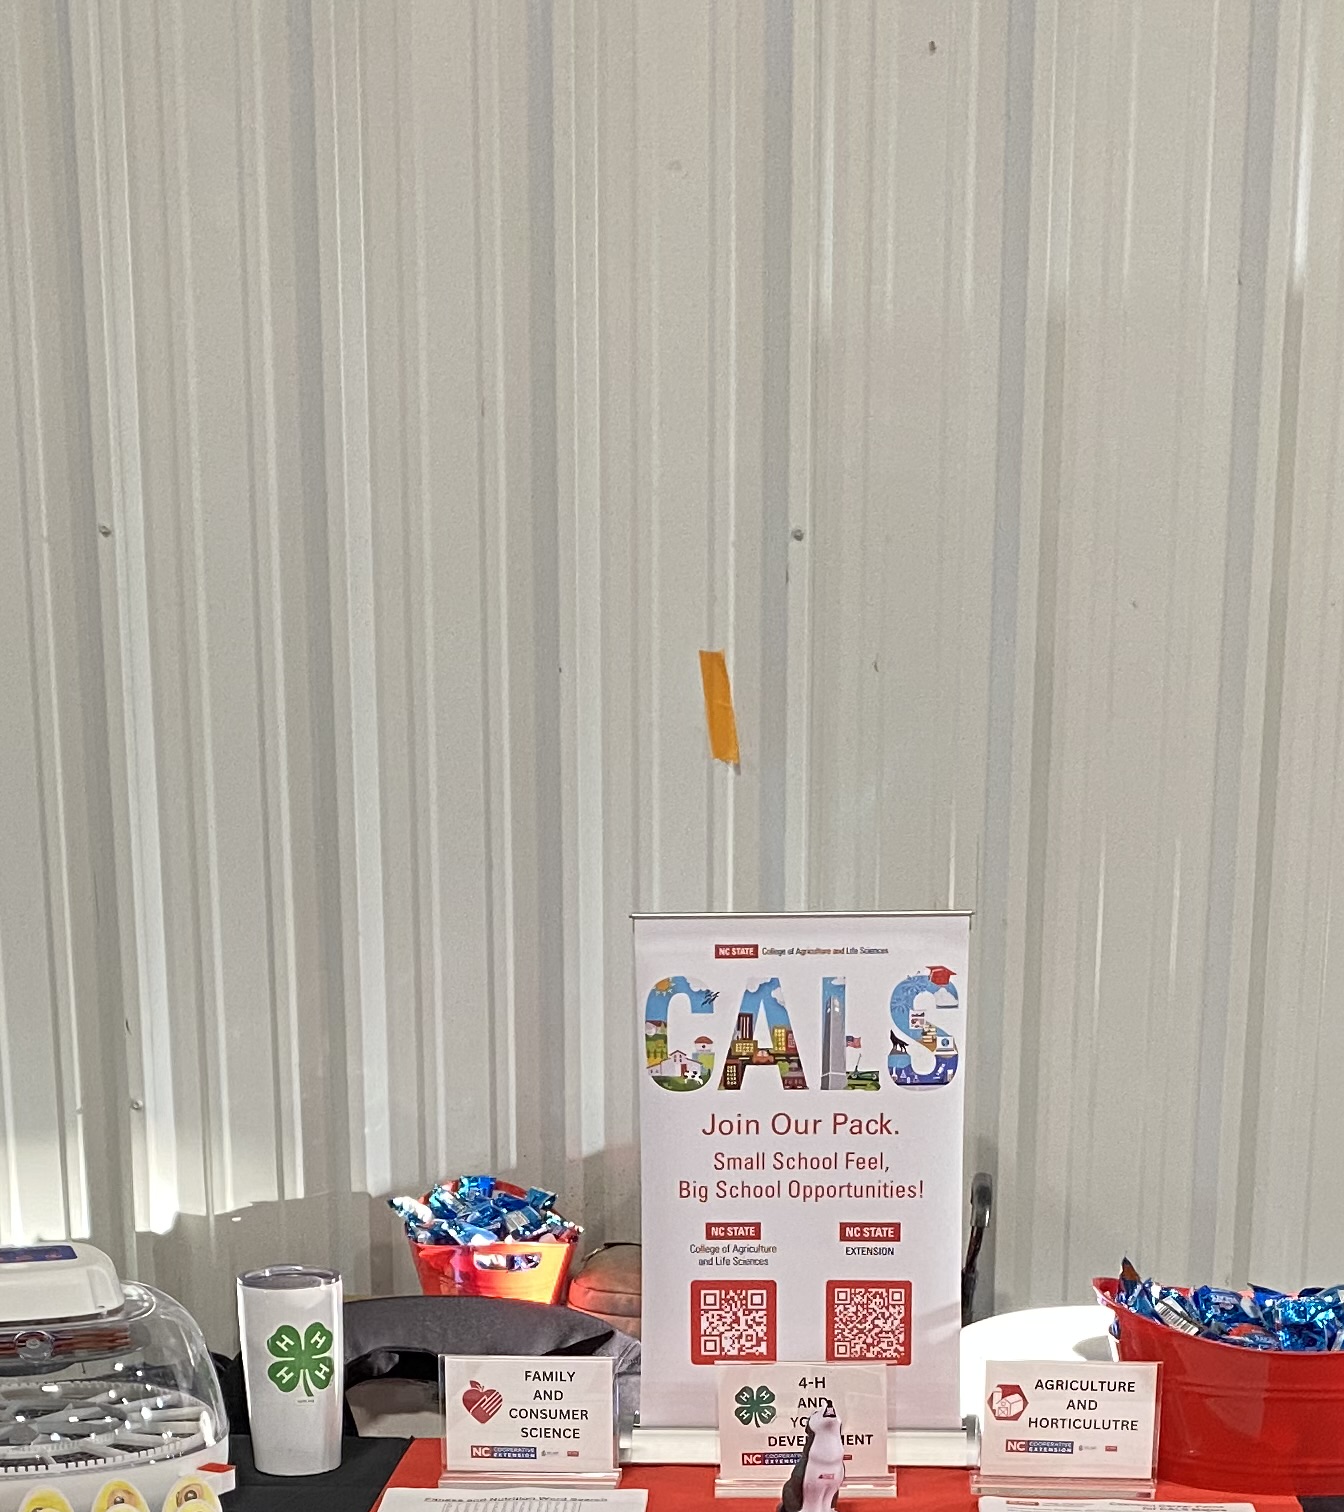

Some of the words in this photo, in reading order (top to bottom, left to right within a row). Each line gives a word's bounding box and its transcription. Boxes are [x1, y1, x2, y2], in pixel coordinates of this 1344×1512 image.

[718, 947, 730, 956] NC
[731, 947, 754, 956] STATE
[644, 970, 959, 1092] CALS
[702, 1112, 760, 1136] Join
[771, 1112, 822, 1136] Our
[832, 1112, 900, 1136] Pack.
[713, 1152, 766, 1172] Small
[772, 1152, 838, 1172] School
[845, 1152, 890, 1174] Feel,
[678, 1180, 708, 1202] Big
[715, 1180, 781, 1199] School
[788, 1180, 924, 1202] Opportunities!
[710, 1226, 725, 1238] NC
[727, 1226, 756, 1238] STATE
[845, 1226, 861, 1239] NC
[864, 1226, 895, 1239] STATE
[689, 1243, 720, 1255] College
[721, 1243, 731, 1253] of
[732, 1243, 778, 1255] Agriculture
[845, 1246, 895, 1256] EXTENSION
[698, 1256, 713, 1266] and
[715, 1256, 731, 1266] Life
[732, 1256, 769, 1266] Sciences
[524, 1370, 576, 1382] FAMILY
[798, 1376, 826, 1389] 4-H
[1034, 1379, 1136, 1393] AGRICULTURE
[533, 1389, 564, 1401] AND
[1066, 1399, 1098, 1411] AND
[508, 1408, 589, 1421] CONSUMER
[1028, 1417, 1139, 1431] HORTICULUTRE
[520, 1427, 580, 1439] SCIENCE
[767, 1433, 874, 1448] DEVEENT
[1006, 1440, 1026, 1452] NC
[472, 1446, 491, 1457] NC
[743, 1454, 762, 1465] NC
